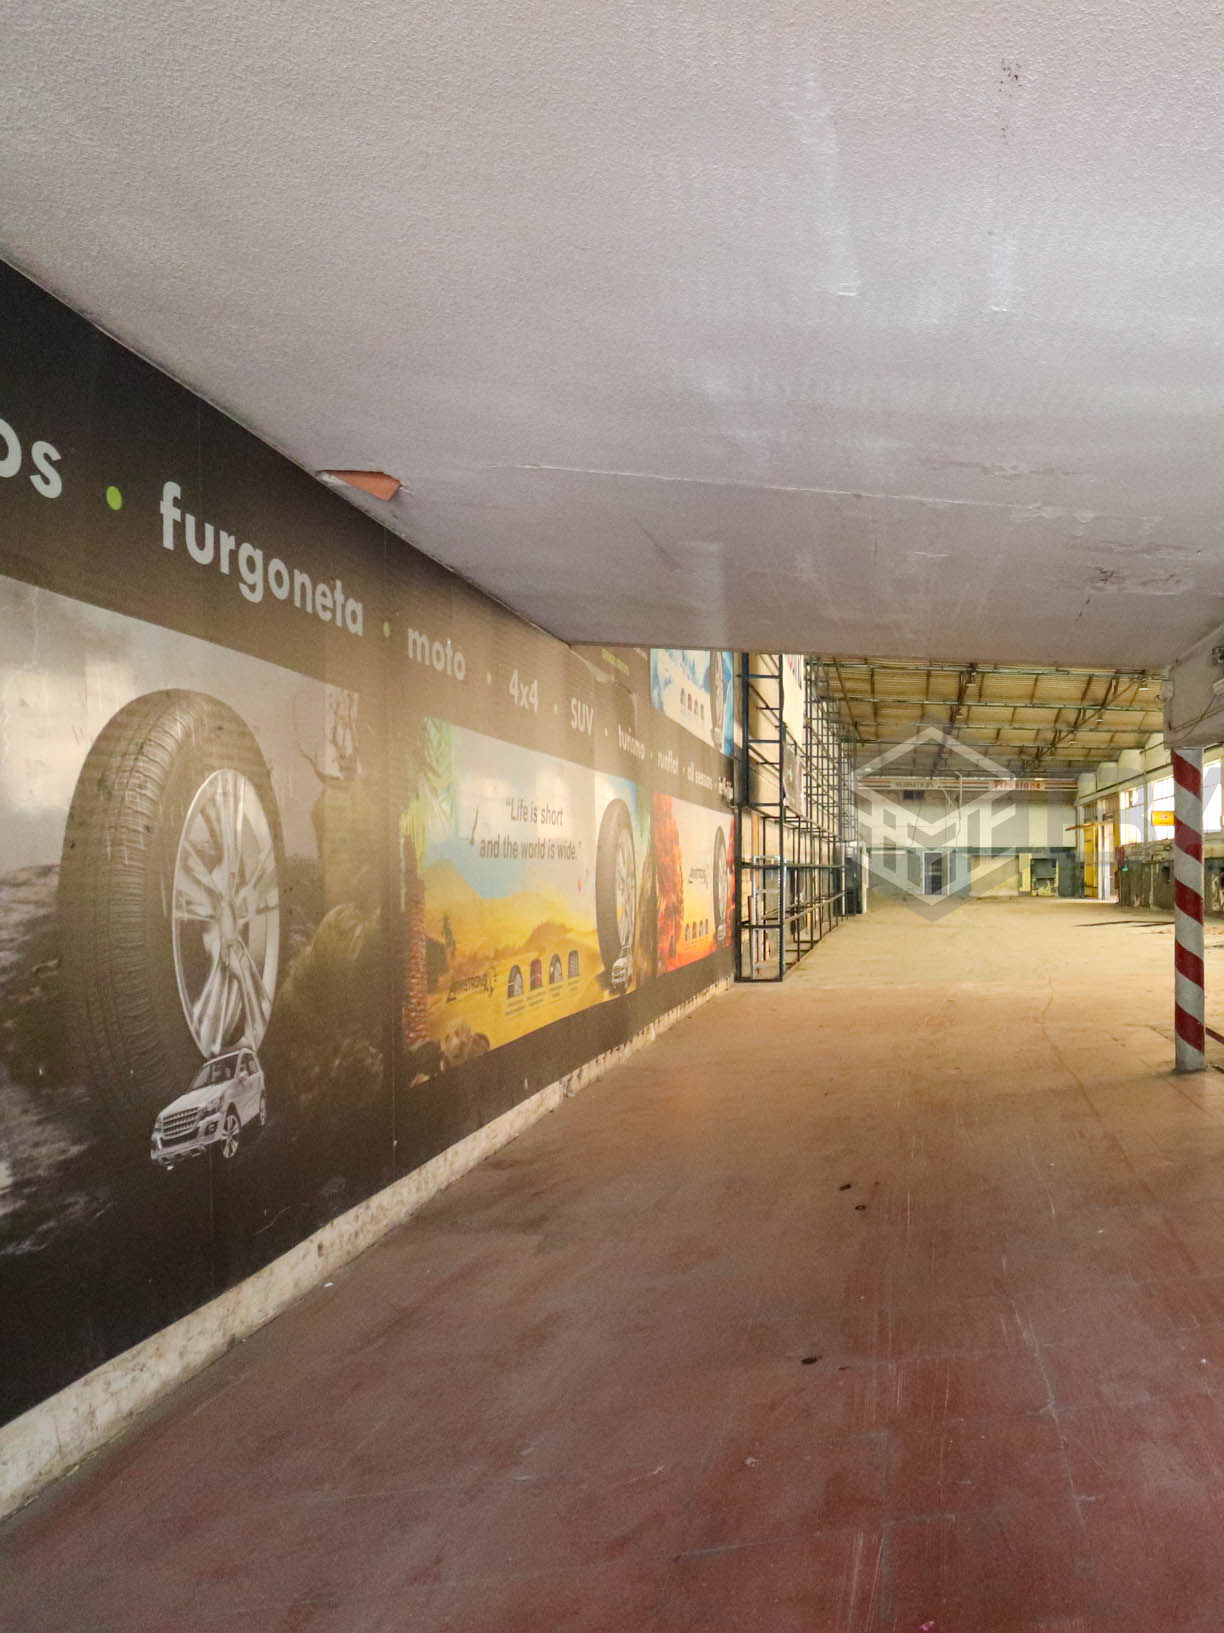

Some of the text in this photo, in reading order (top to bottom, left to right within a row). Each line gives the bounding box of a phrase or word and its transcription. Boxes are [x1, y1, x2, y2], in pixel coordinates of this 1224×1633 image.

[159, 481, 364, 636] furgoneta
[407, 627, 467, 682] moto
[508, 669, 540, 712] 4x4
[570, 697, 595, 736] SUV
[618, 723, 646, 761] turismo
[530, 801, 538, 824] is
[540, 803, 564, 826] short
[479, 834, 500, 859] and
[503, 834, 519, 859] the
[521, 838, 546, 860] world
[548, 839, 556, 860] is
